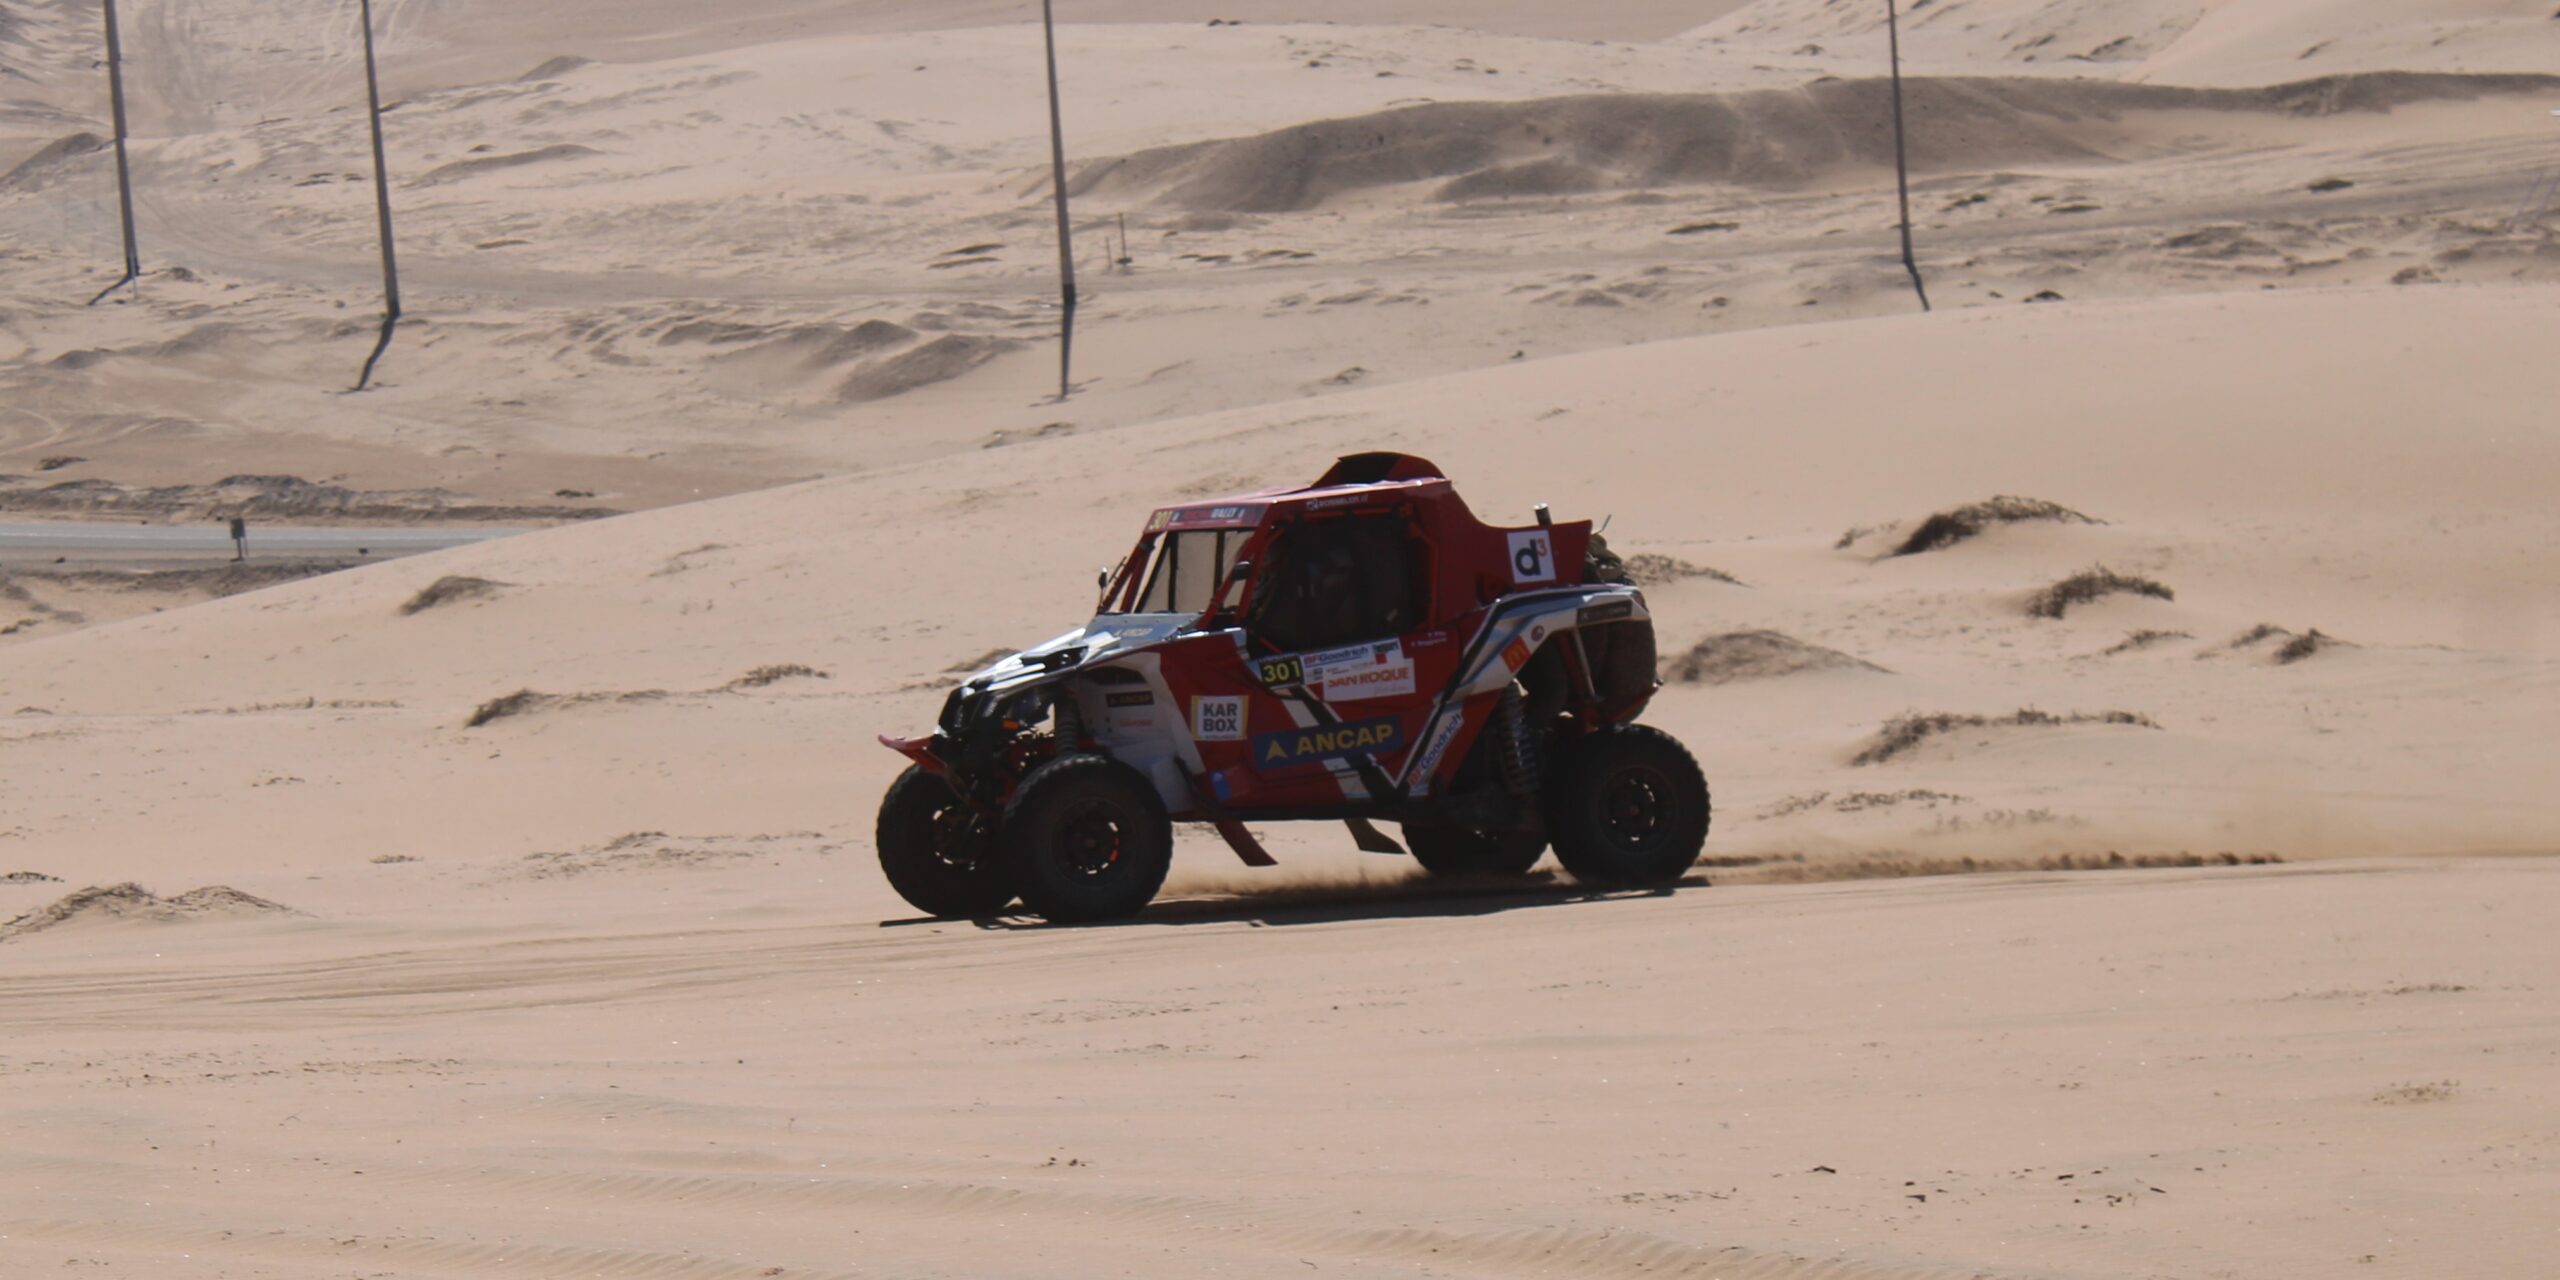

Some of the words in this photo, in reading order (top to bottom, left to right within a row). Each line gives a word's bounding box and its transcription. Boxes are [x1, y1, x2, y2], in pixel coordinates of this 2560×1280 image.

[1304, 647, 1369, 666] BFGoodrich
[1264, 660, 1301, 683] 301
[1327, 675, 1358, 689] SAN
[1359, 667, 1409, 685] ROQUE
[1203, 703, 1238, 717] KAR
[1203, 718, 1238, 733] BOX
[1296, 724, 1394, 756] ANCAP
[1408, 713, 1462, 785] BFGoodrich
